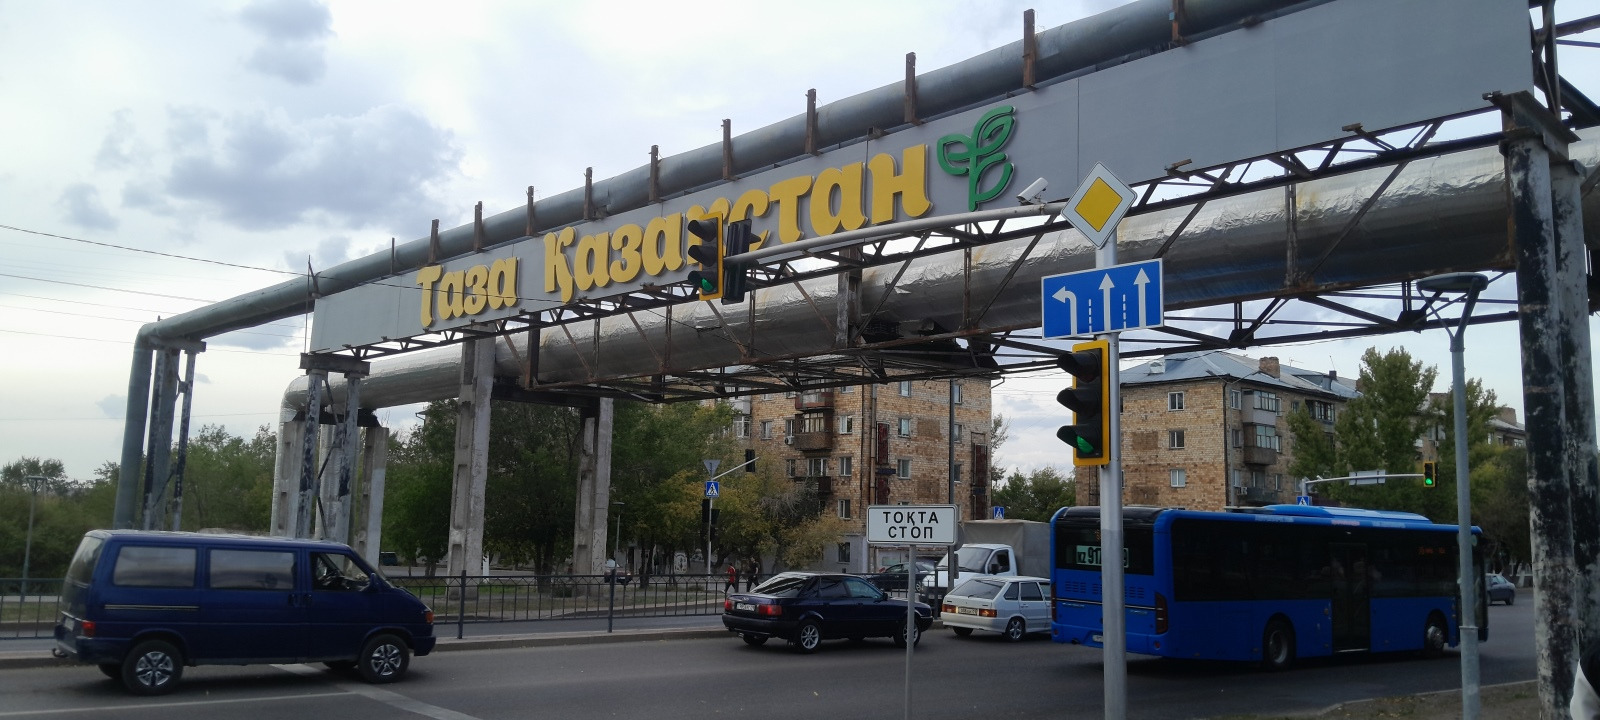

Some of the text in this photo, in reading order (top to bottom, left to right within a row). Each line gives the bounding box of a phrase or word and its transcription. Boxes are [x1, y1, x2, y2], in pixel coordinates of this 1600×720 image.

[416, 265, 520, 327] Таза
[883, 511, 939, 526] ТОҚТА
[888, 526, 933, 539] СТОП
